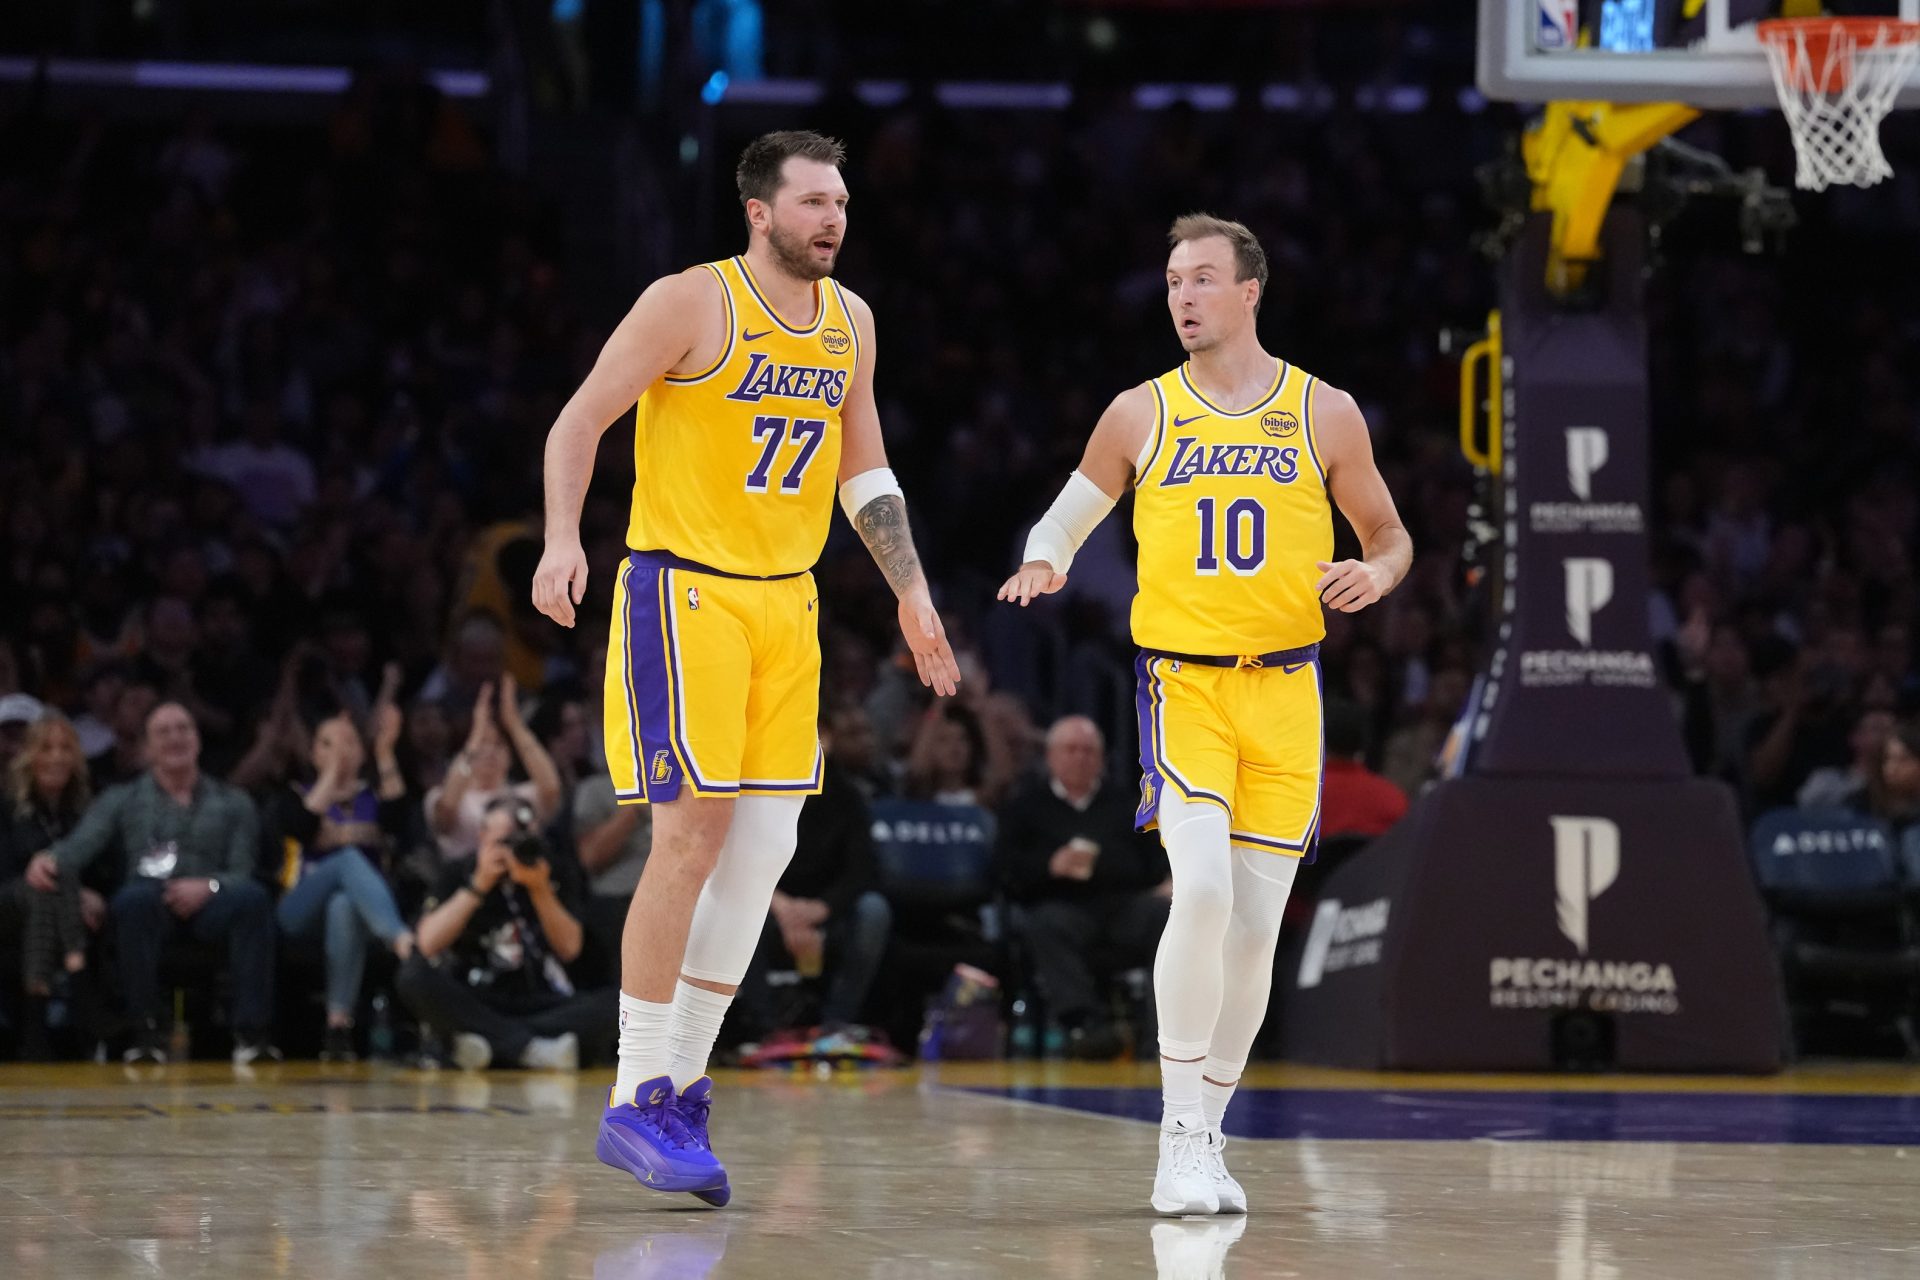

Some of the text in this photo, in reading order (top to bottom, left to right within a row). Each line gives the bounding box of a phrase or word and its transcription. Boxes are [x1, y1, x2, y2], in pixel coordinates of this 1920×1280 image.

[823, 335, 848, 347] bibigo
[725, 353, 848, 409] LAKERS
[1264, 417, 1296, 430] bibigo
[744, 415, 827, 495] 77
[1158, 436, 1301, 487] LAKERS
[1195, 496, 1267, 577] 10
[1491, 958, 1676, 992] PECHANGA
